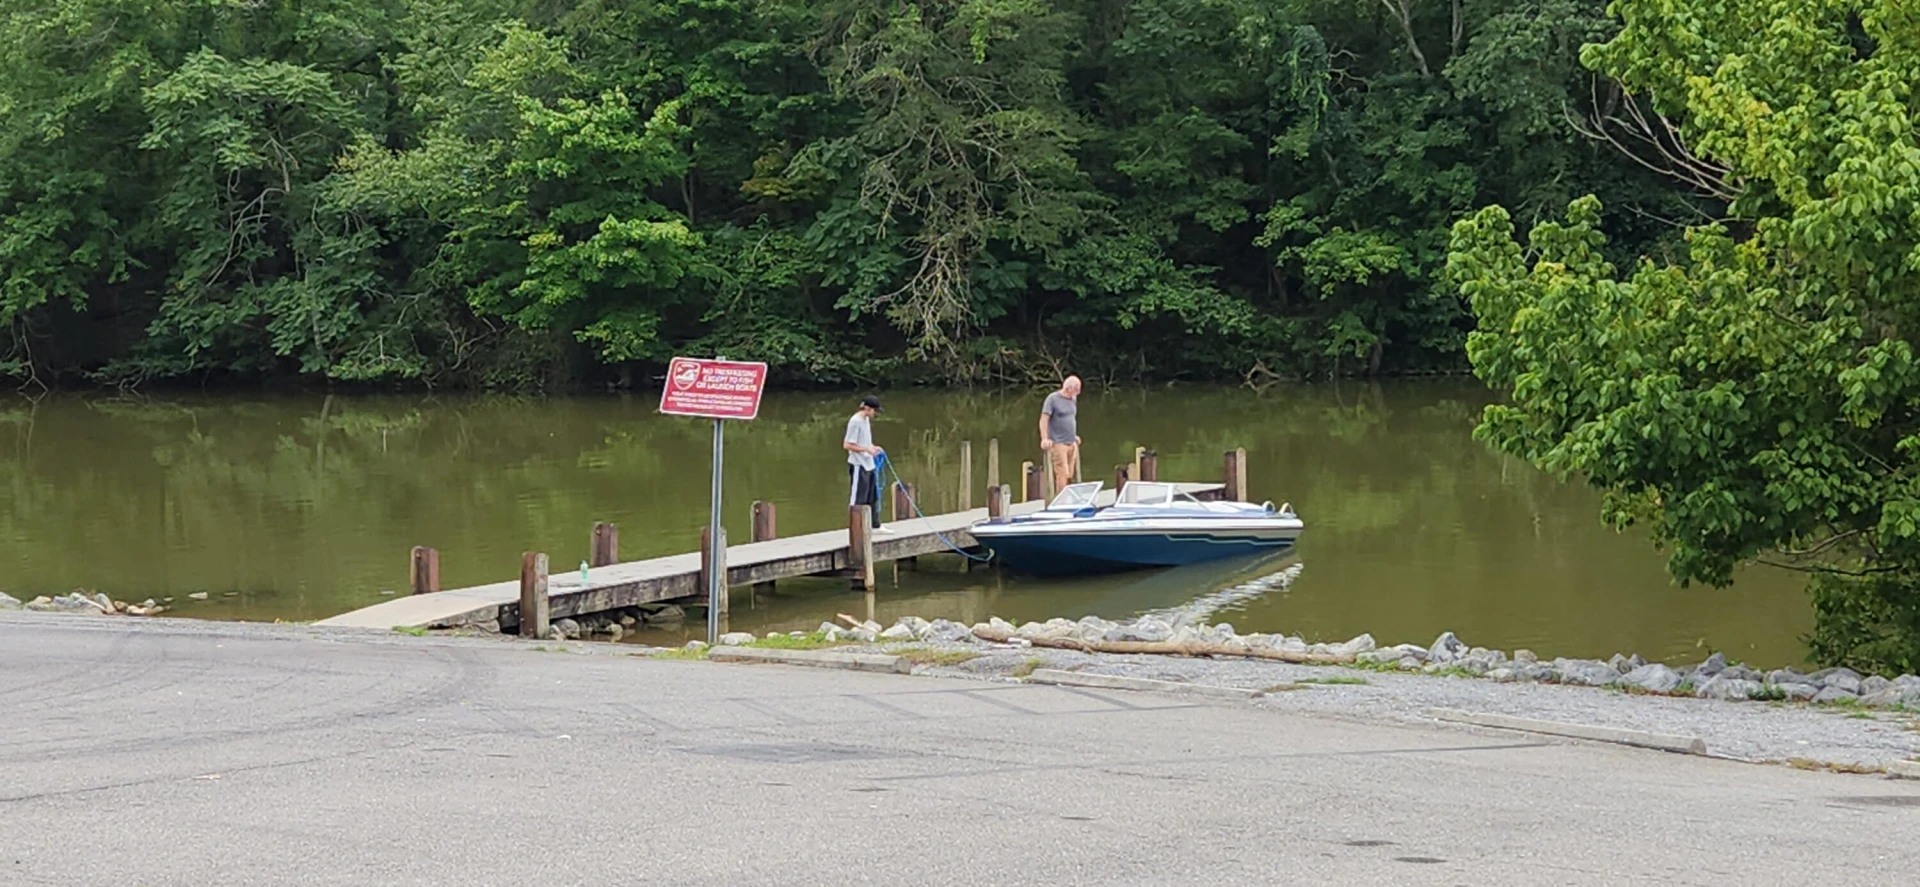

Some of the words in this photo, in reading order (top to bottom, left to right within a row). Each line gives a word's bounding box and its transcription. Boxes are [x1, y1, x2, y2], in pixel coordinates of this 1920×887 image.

[703, 375, 728, 383] EXCEPT
[729, 376, 737, 384] TO
[696, 381, 706, 389] OR
[707, 382, 735, 390] LAUNCH
[735, 384, 757, 392] BOATS
